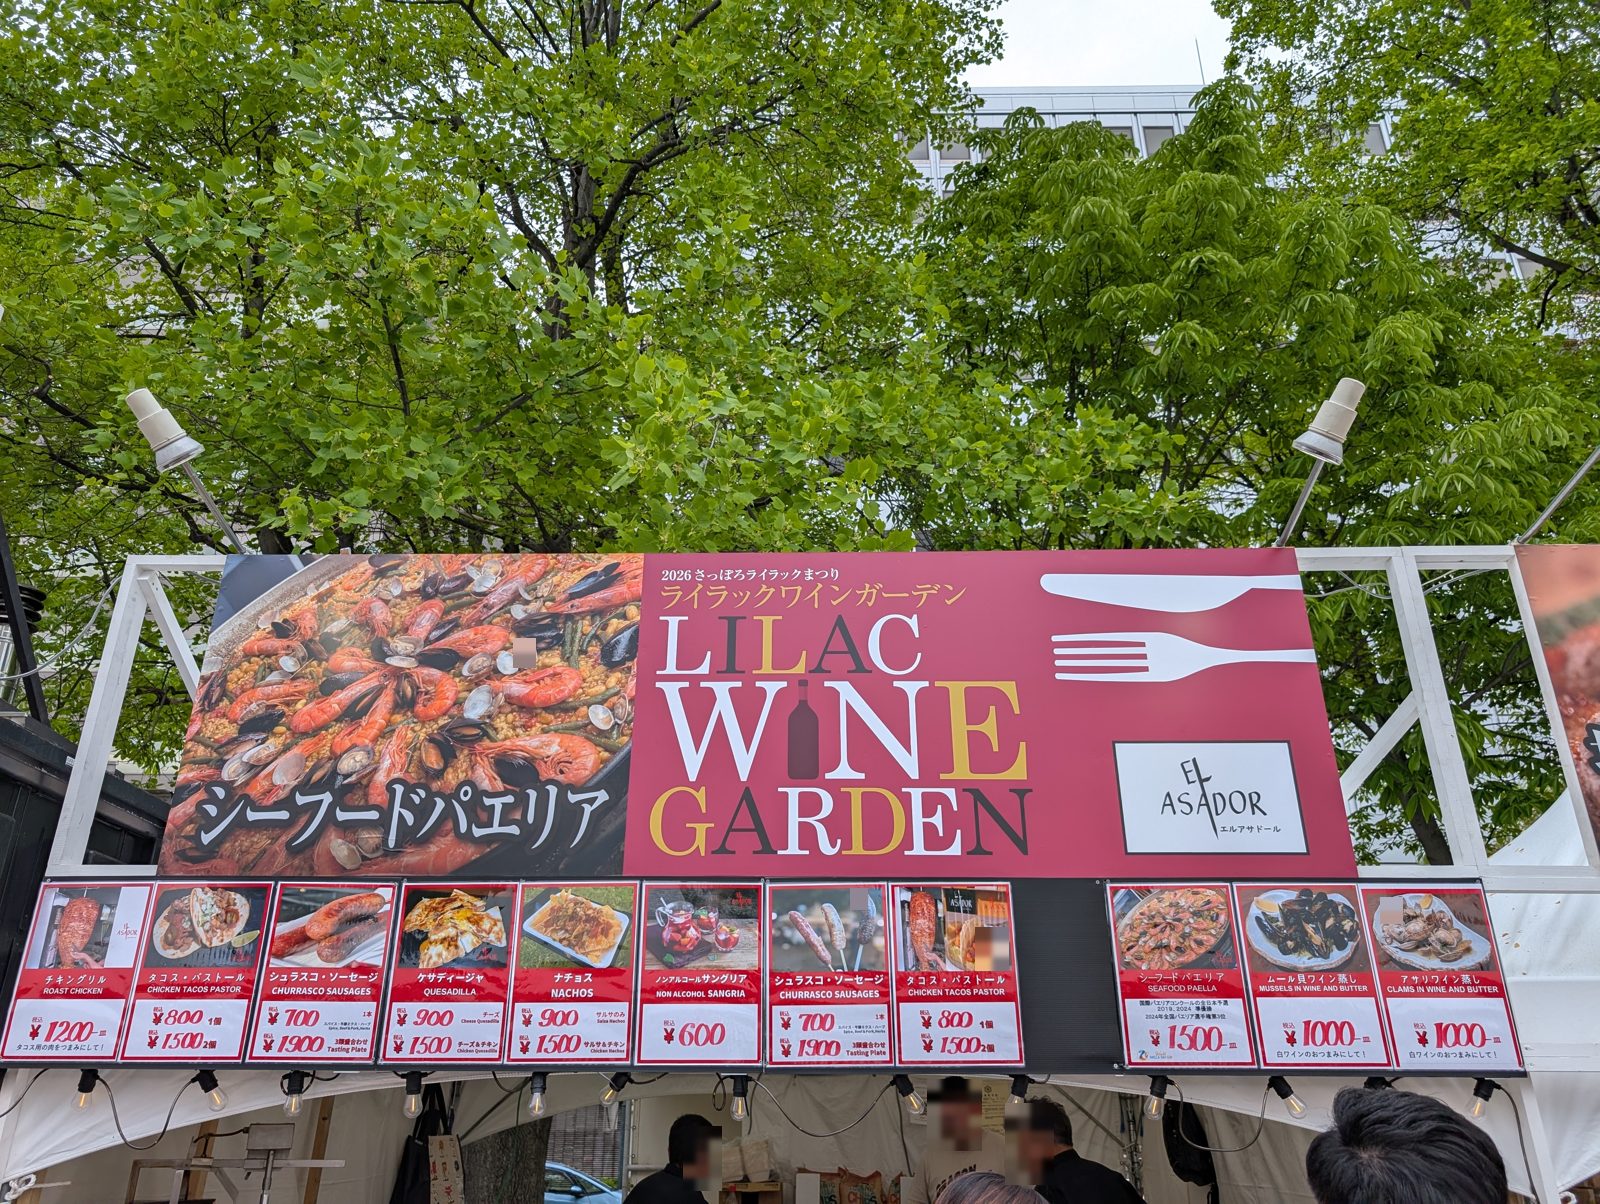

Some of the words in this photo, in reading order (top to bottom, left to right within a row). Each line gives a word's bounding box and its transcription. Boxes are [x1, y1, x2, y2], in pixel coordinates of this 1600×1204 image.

[660, 582, 967, 610] ライラックワインガーデン
[656, 613, 922, 675] LILAC
[1161, 790, 1267, 816] ASADOR
[200, 783, 610, 850] シーフードパエリア
[649, 786, 1033, 857] GARDEN
[1220, 825, 1281, 833] エルアサドール
[45, 975, 106, 984] チキングリル
[270, 972, 378, 982] シュラスコ・ソーセージ
[417, 973, 484, 983] ケサディージャ
[554, 973, 592, 982] ナチョス
[775, 975, 884, 986] シュラスコ・ソーセージ
[1268, 974, 1357, 984] ムール貝ワイン蒸し
[1401, 975, 1480, 984] アサリワイン蒸し
[327, 987, 371, 995] SAUSAGES
[424, 988, 476, 996] QUESADILLA
[551, 989, 593, 997] NACHOS
[780, 991, 832, 999] CHURRASCO
[835, 990, 879, 998] SAUSAGES
